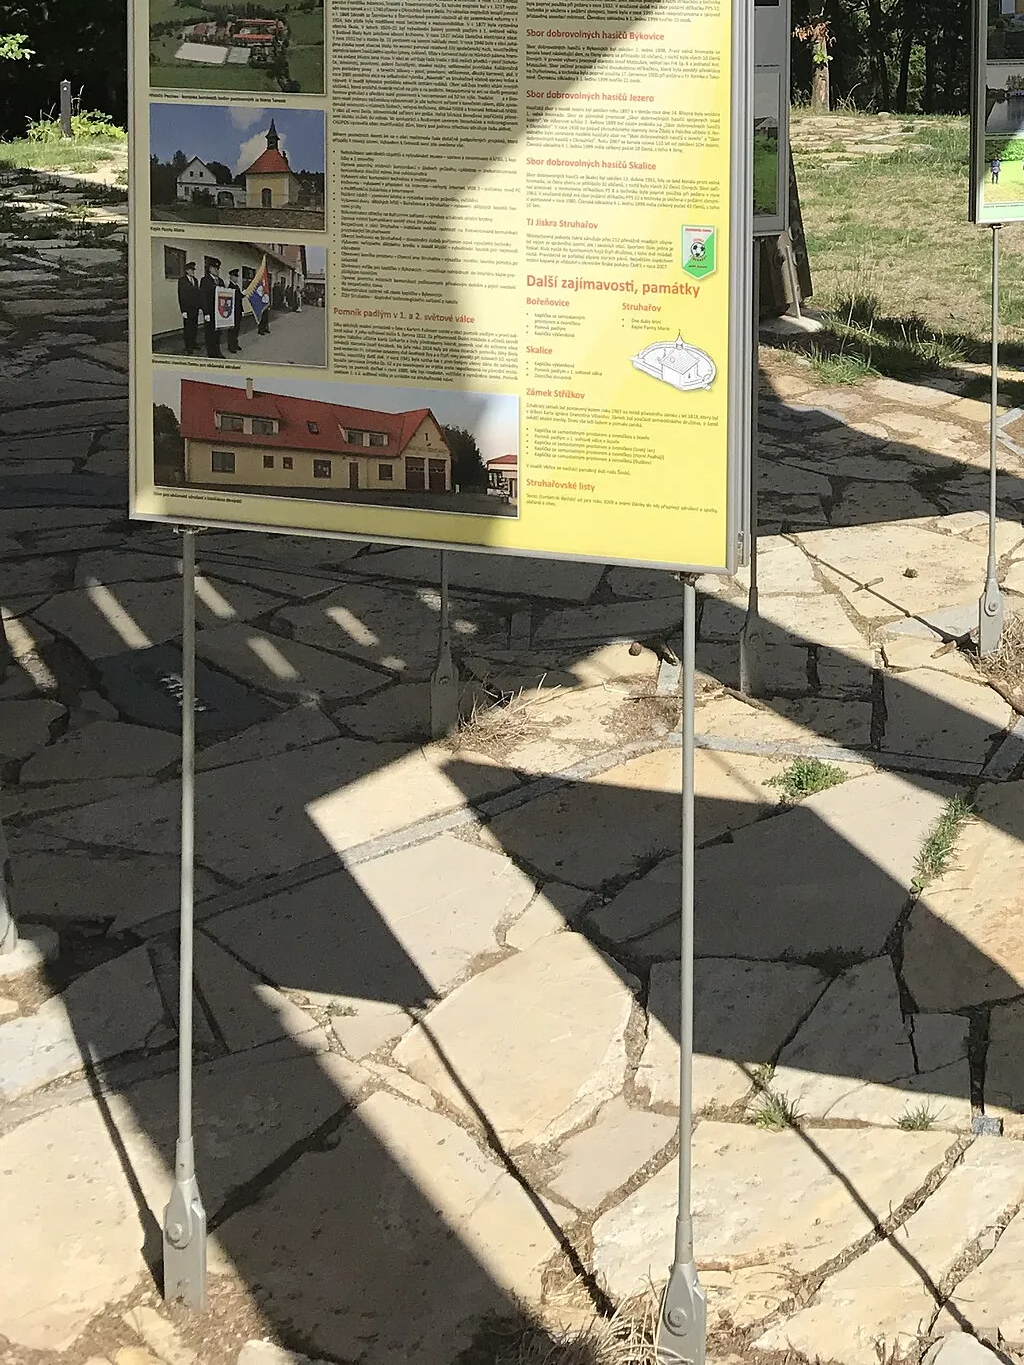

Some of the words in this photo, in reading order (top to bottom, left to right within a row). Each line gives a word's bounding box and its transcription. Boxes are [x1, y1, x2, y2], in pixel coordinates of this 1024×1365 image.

[526, 29, 545, 37] Sbor
[546, 29, 600, 40] dobrovolných
[602, 30, 628, 40] hasičů
[630, 32, 664, 41] Býkovice
[526, 90, 544, 98] Sbor
[546, 90, 600, 101] dobrovolných
[602, 92, 627, 101] hasičů
[629, 94, 654, 102] Jezero
[526, 157, 544, 166] Sbor
[546, 158, 600, 169] dobrovolných
[602, 160, 627, 169] hasičů
[629, 162, 656, 170] Skalice
[526, 218, 534, 226] TJ
[536, 218, 557, 227] Jiskra
[559, 220, 598, 229] Struhařov
[527, 275, 558, 288] Další
[561, 277, 638, 294] zajímavosti,
[642, 281, 701, 298] památky
[526, 297, 570, 307] Bořeňovice
[622, 302, 661, 312] Struhařov
[334, 307, 362, 316] Pomník
[363, 310, 392, 319] padlým
[400, 311, 406, 319] 1.
[415, 312, 422, 320] 2.
[424, 313, 453, 322] světové
[455, 315, 475, 324] válce
[526, 346, 553, 354] Skalice
[526, 388, 552, 397] Zámek
[554, 390, 585, 399] Střížkov
[526, 478, 577, 490] Struhařovské
[579, 482, 595, 493] listy
